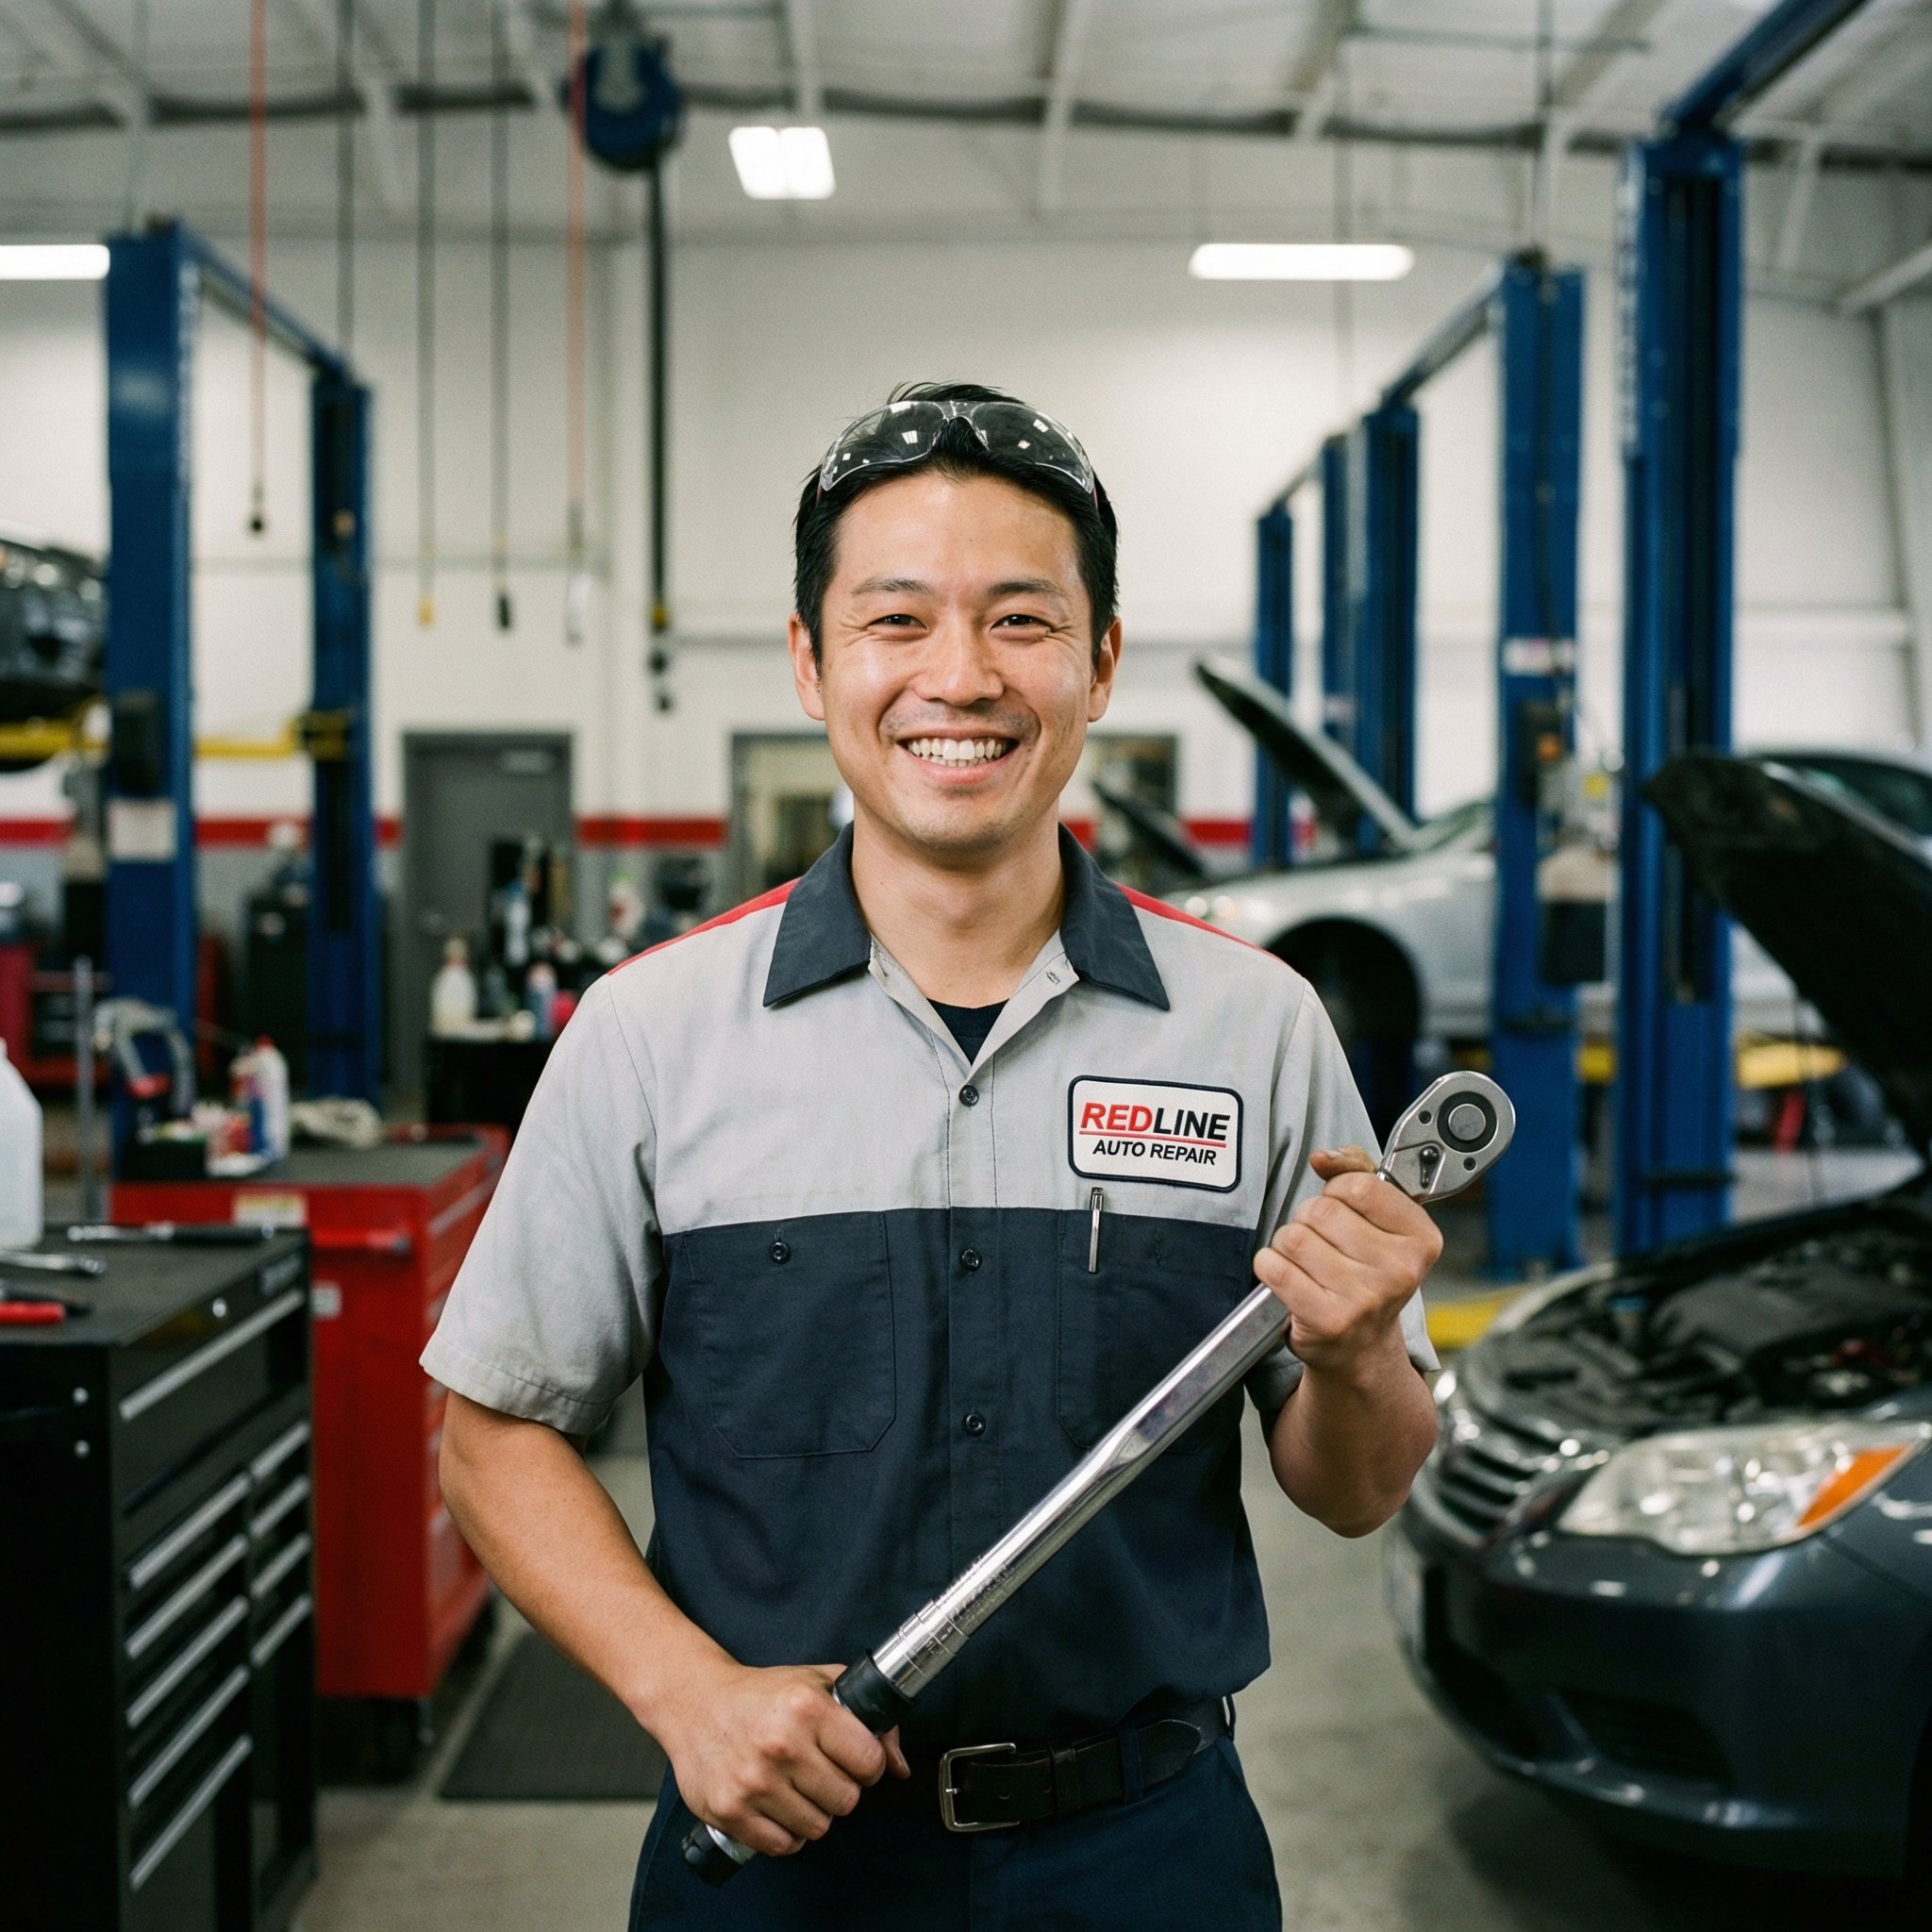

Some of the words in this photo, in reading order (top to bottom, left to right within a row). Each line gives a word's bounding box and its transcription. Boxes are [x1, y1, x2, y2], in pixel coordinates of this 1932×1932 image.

[1080, 1102, 1230, 1141] REDLINE
[1092, 1140, 1145, 1157] AUTO
[1150, 1143, 1216, 1165] REPAIR
